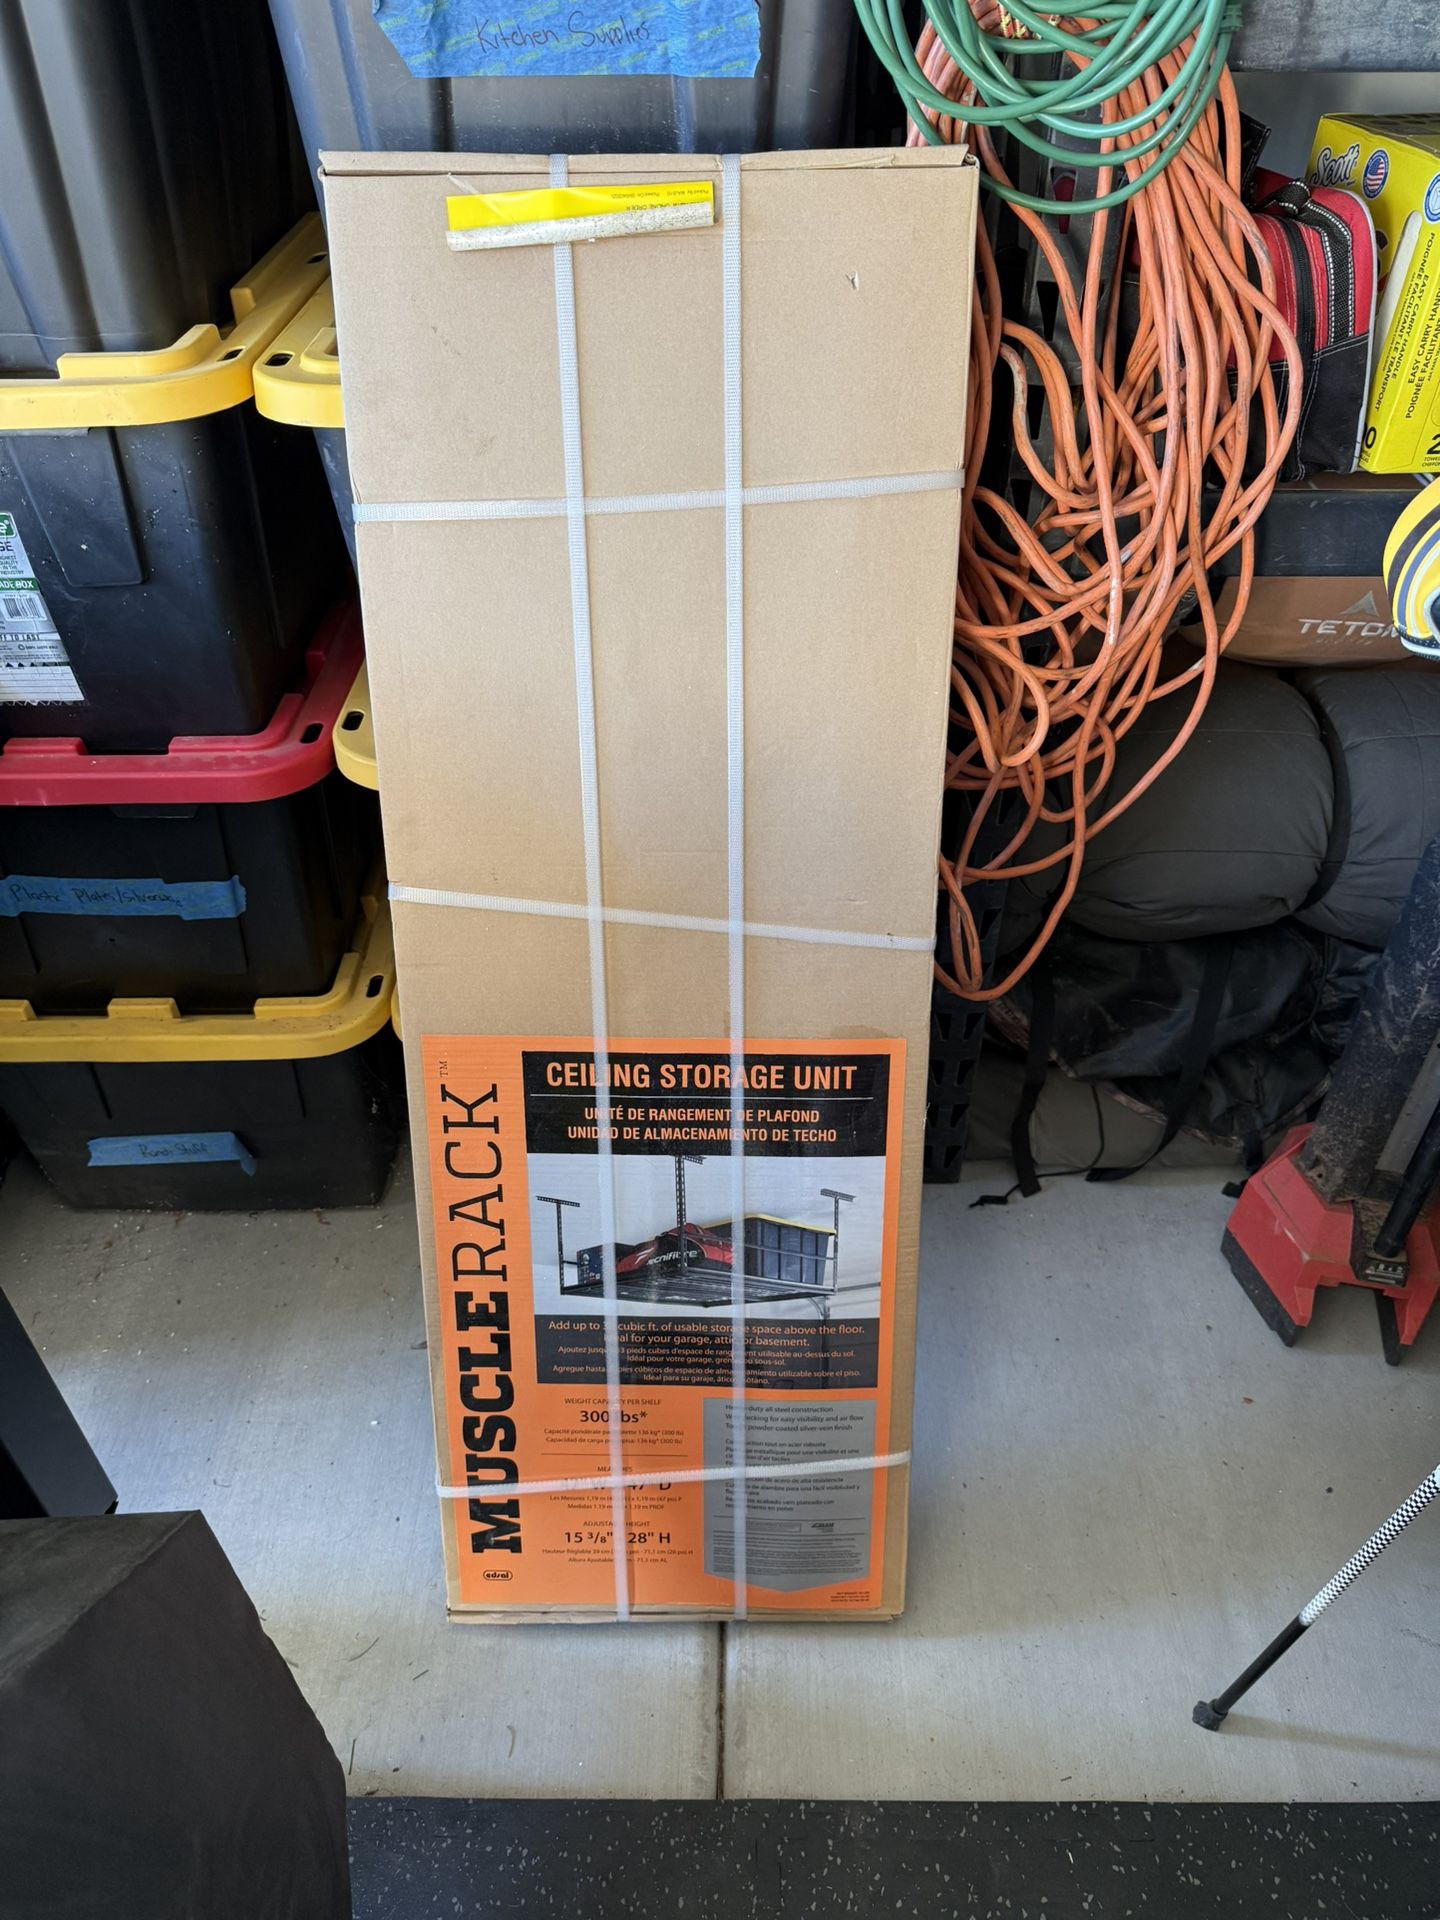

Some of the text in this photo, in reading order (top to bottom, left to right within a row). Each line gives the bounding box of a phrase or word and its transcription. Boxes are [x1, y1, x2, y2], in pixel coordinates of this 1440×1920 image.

[474, 10, 651, 53] Kitchen Supplies
[1311, 144, 1359, 187] Scott
[1391, 275, 1429, 379] EASY CARRY HANDLE
[1408, 359, 1420, 383] EASY
[1417, 324, 1433, 356] CARRY
[1405, 376, 1425, 418] POIGNÉE
[15, 580, 34, 588] BOX
[546, 1062, 857, 1090] CEILING STORAGE UNIT
[585, 1105, 820, 1123] UNTÉ DE RANGEMENT DE PLAFOND
[623, 1127, 640, 1140] DE
[772, 1129, 789, 1142] DE
[793, 1129, 837, 1142] TECHO
[548, 1321, 572, 1330] Add
[573, 1322, 587, 1332] up
[589, 1322, 600, 1330] to
[618, 1321, 645, 1331] cubic
[647, 1322, 659, 1331] ft.
[661, 1322, 673, 1331] of
[674, 1322, 708, 1331] usable
[711, 1323, 749, 1334] storae
[752, 1326, 781, 1336] space
[784, 1325, 816, 1335] above
[818, 1325, 836, 1335] the
[838, 1324, 865, 1334] floor.
[631, 1333, 645, 1343] for
[648, 1335, 671, 1345] your
[673, 1335, 712, 1346] garage,
[714, 1336, 738, 1344] atti
[755, 1337, 810, 1347] basement.
[558, 1346, 586, 1355] Ajoutez
[626, 1347, 647, 1355] pieds
[648, 1347, 670, 1355] cubes
[672, 1347, 702, 1356] d'espace
[758, 1350, 791, 1358] utilisable
[793, 1350, 830, 1358] au-dessus
[552, 1365, 584, 1373] Agregue
[580, 1410, 609, 1423] 300
[565, 1532, 583, 1543] 15
[628, 1532, 654, 1543] 28"
[659, 1532, 670, 1543] H
